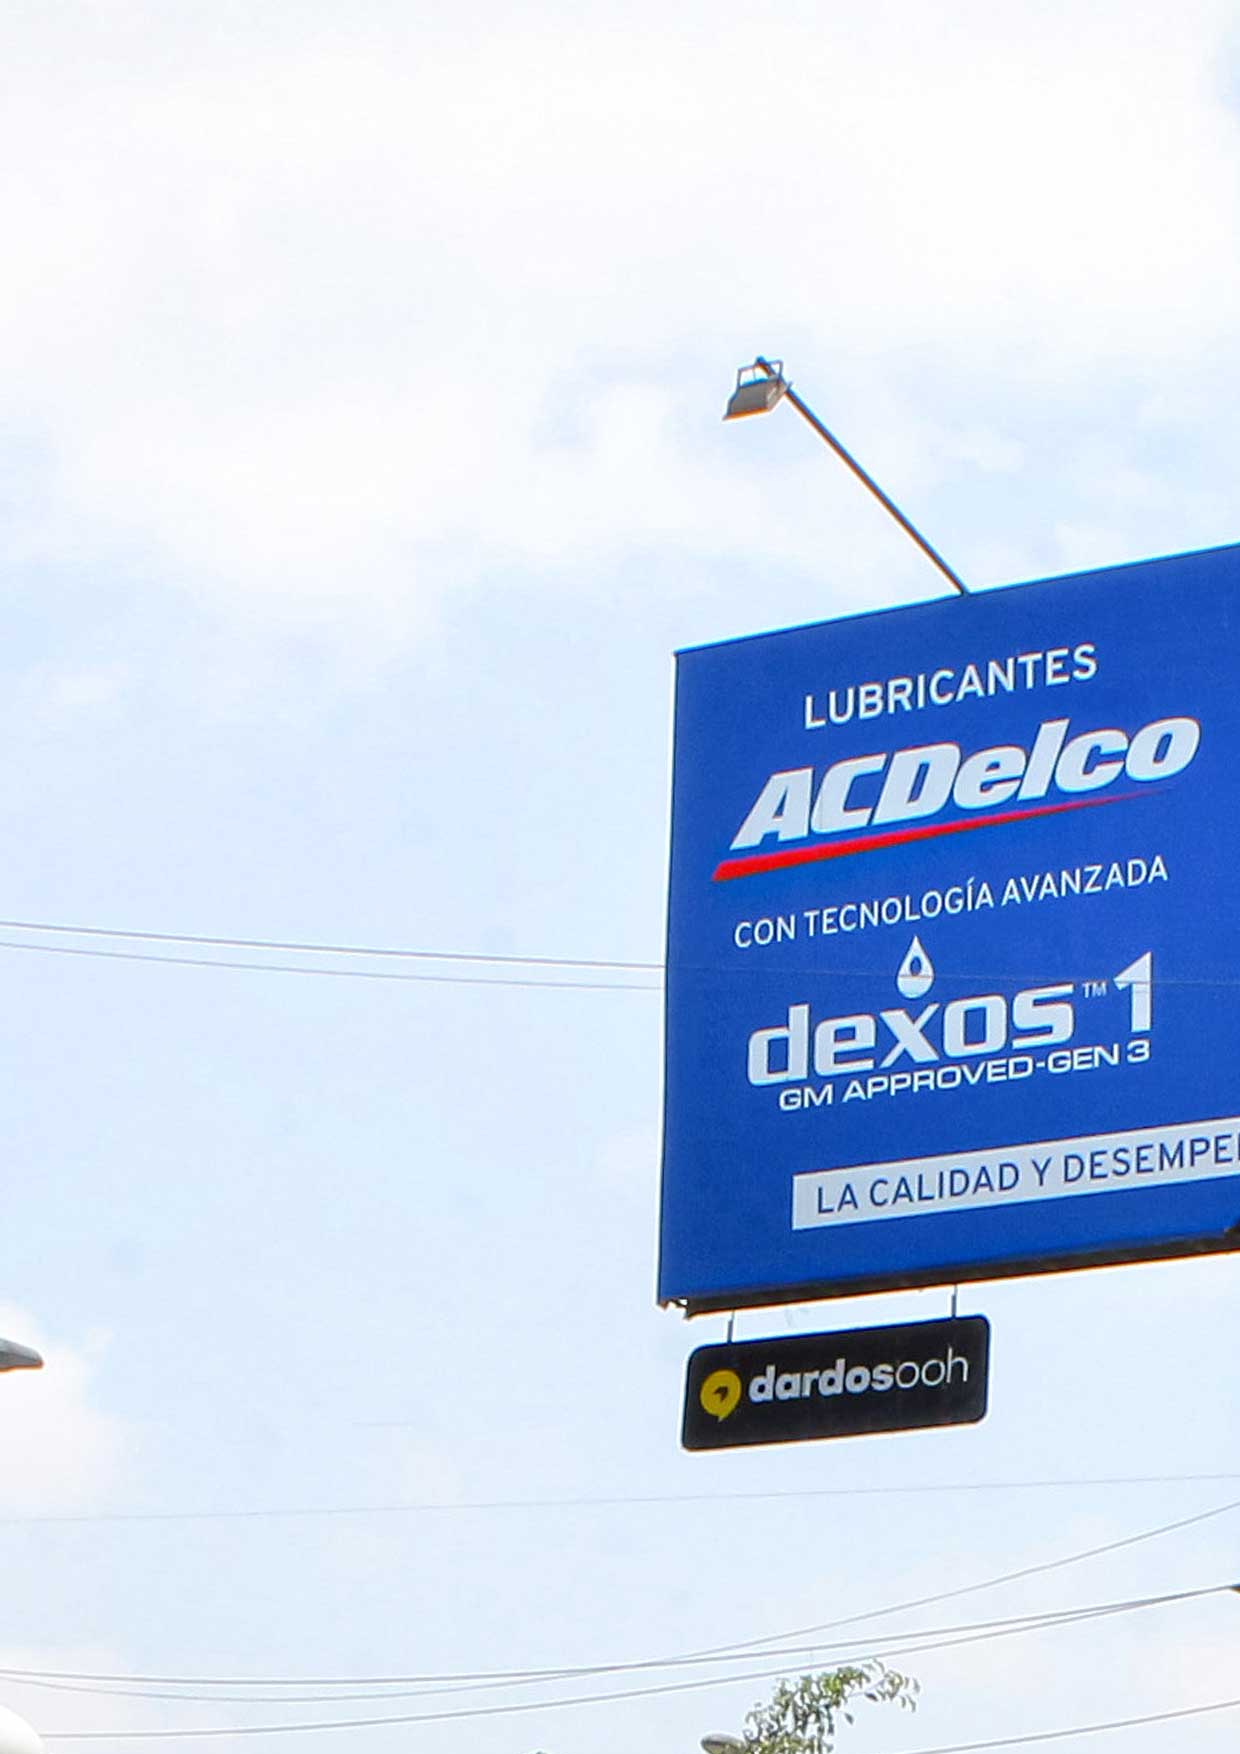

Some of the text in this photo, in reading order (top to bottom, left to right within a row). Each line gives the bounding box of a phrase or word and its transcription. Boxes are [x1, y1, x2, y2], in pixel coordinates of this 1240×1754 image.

[803, 643, 1098, 730] LUBRICANTES
[730, 717, 1201, 851] ACDelco
[735, 855, 1170, 948] CON TECNOLOGÍA AVANZADA
[748, 983, 1075, 1086] dexos
[1112, 951, 1154, 1033] 1
[779, 1083, 833, 1111] GM
[1128, 1040, 1151, 1063] 3
[817, 1183, 859, 1214] LA
[870, 1162, 1021, 1207] CALIDAD
[1032, 1157, 1052, 1187] Y
[750, 1347, 969, 1402] dardosooh
